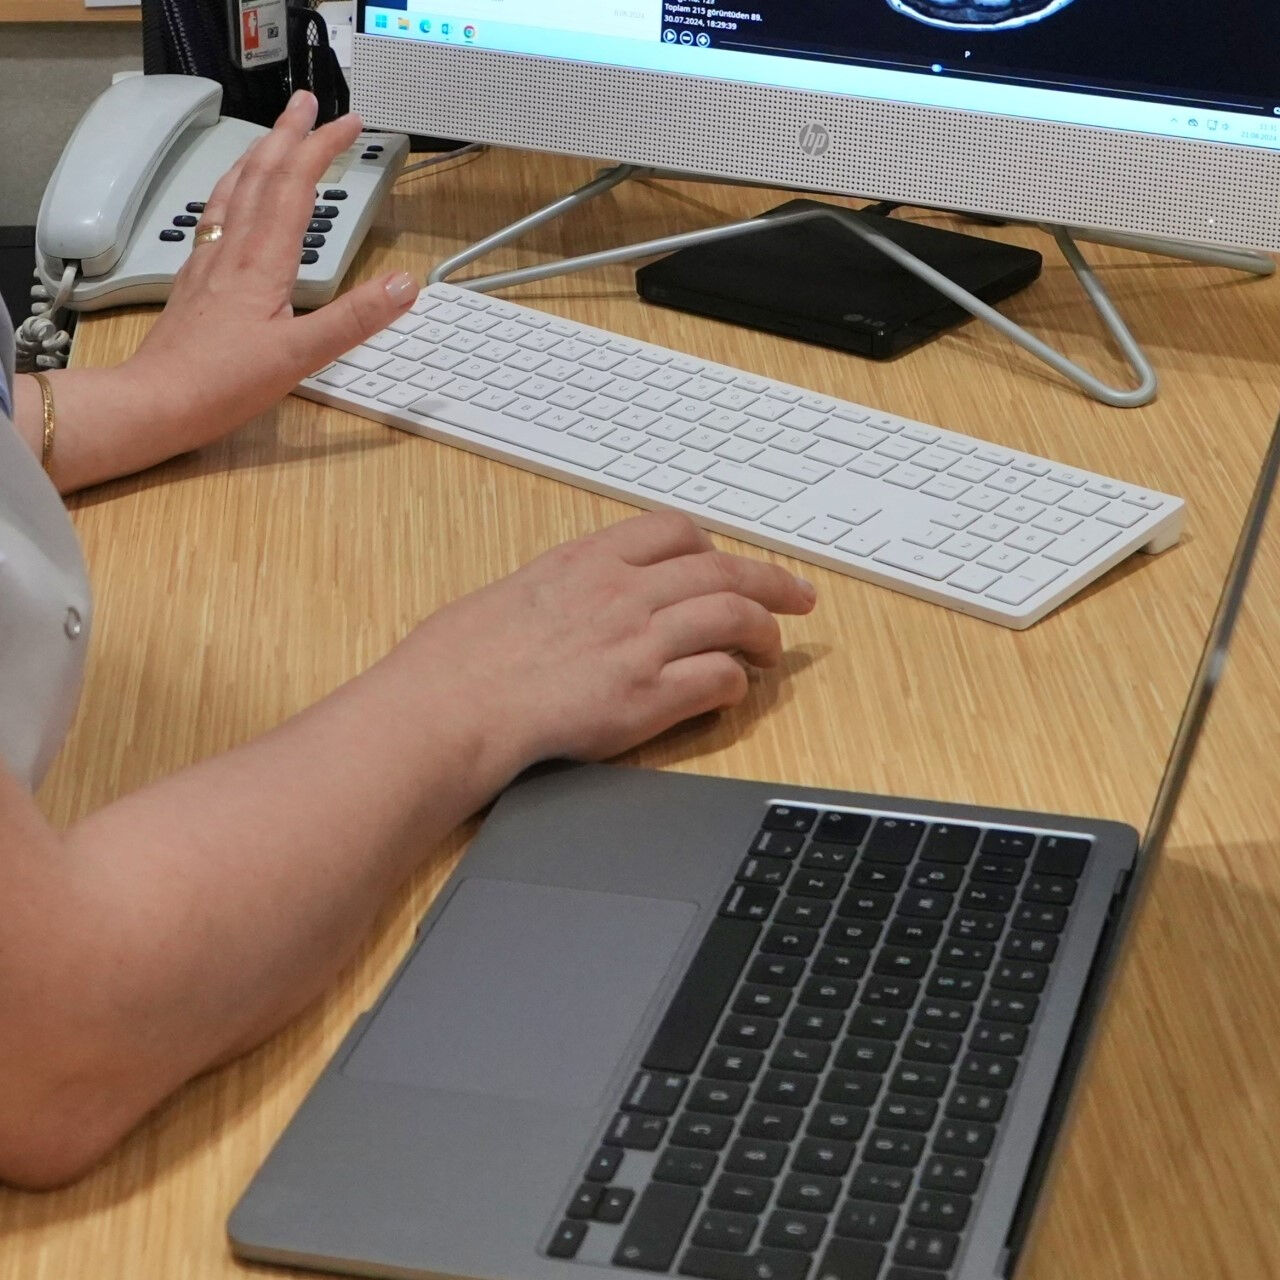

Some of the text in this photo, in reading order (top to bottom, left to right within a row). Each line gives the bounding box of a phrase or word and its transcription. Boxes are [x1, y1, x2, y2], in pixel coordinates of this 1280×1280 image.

[664, 3, 691, 13] Toplam
[692, 6, 706, 15] 215
[707, 8, 750, 20] görüntüden
[664, 14, 705, 27] 30.07.2024,
[801, 122, 828, 157] hp
